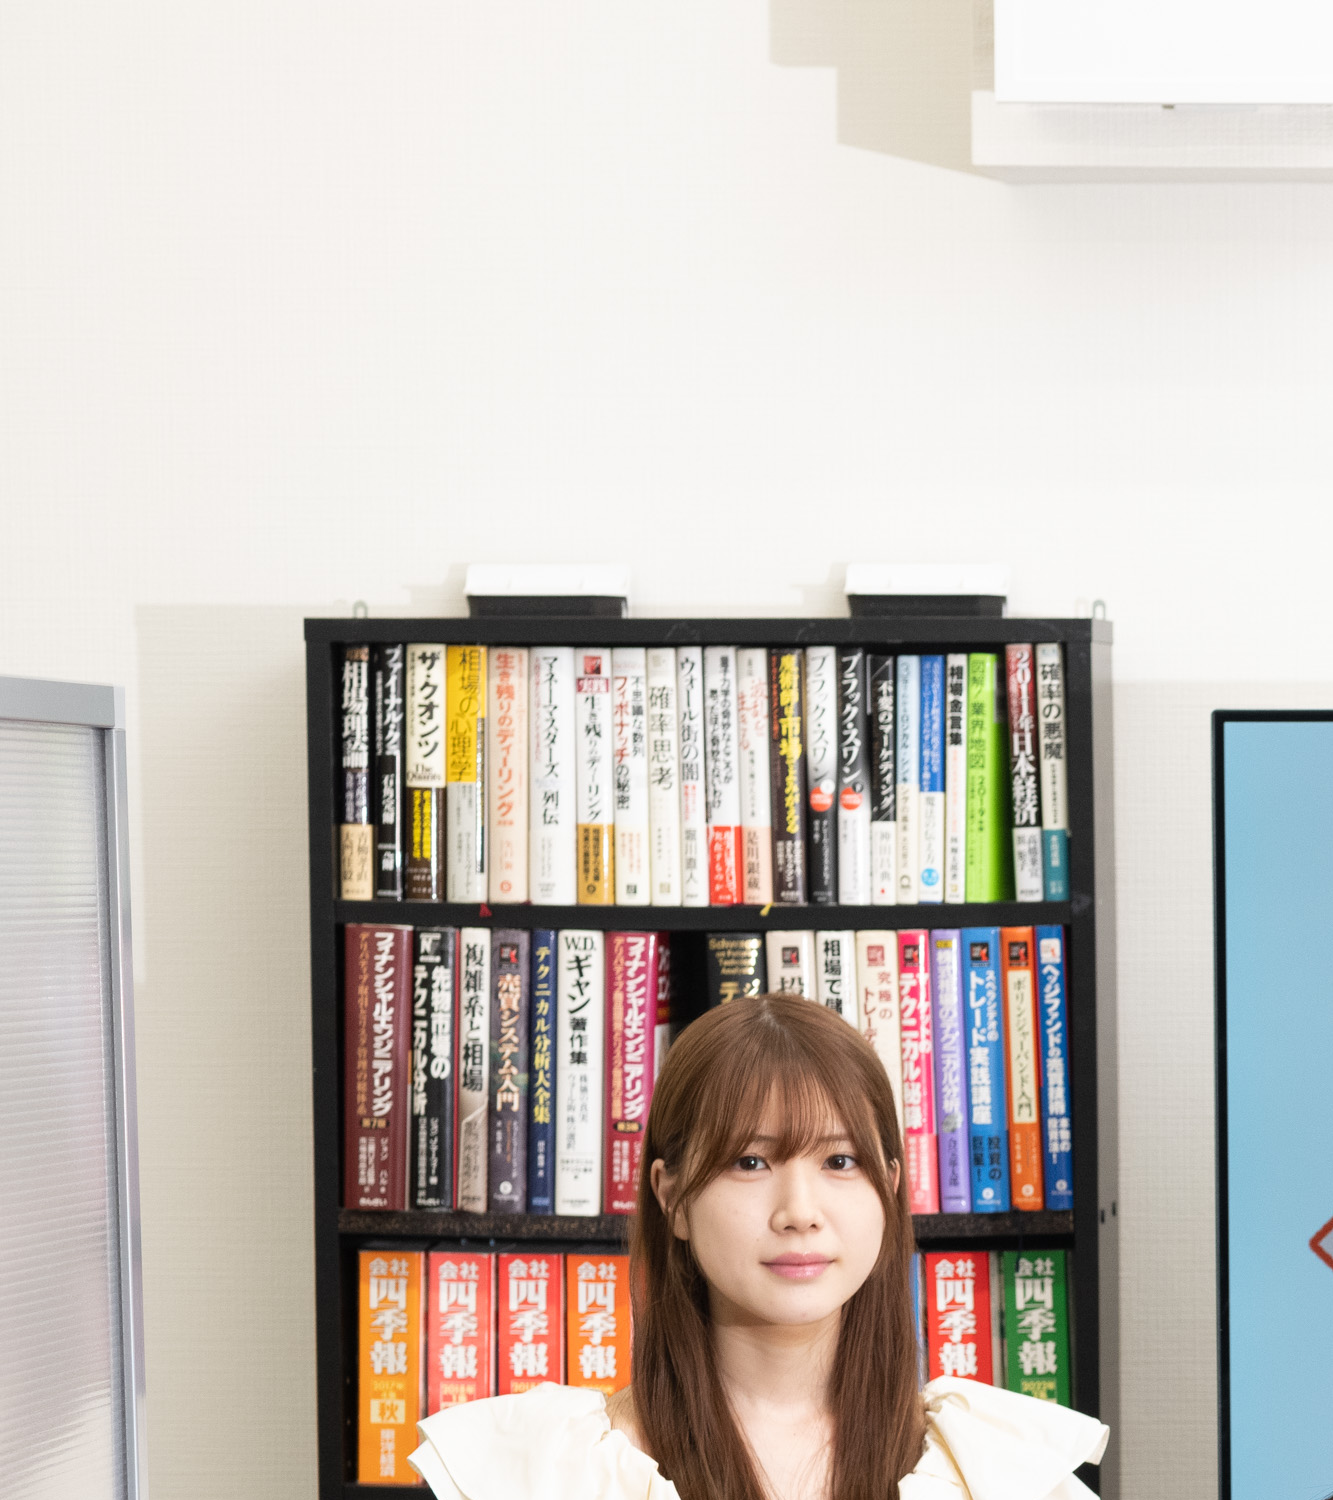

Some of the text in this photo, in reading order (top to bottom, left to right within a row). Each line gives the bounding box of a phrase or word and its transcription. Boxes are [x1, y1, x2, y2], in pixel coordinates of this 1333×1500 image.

[418, 651, 441, 758] ザ・クオンツ
[450, 648, 481, 782] 相場の心理学
[496, 653, 515, 818] 生き残りのディーリング
[614, 676, 631, 811] フィボナッチの秘密
[631, 675, 645, 759] 不思議な数列
[649, 686, 675, 791] 確率思考
[680, 656, 699, 782] ウォール街の闇
[811, 654, 830, 783] ブラック・スワン
[841, 652, 861, 784] ブラック・スワン
[878, 680, 894, 810] 不変のマーケティング
[949, 664, 963, 746] 相場金言集
[1012, 650, 1037, 826] 2011年日本経済
[1041, 663, 1062, 760] 確率の悪魔
[565, 936, 597, 951] W.D.
[876, 971, 892, 1020] 究極の
[372, 932, 395, 1117] フィナンシャルエンジニアリング
[413, 964, 429, 1116] テクニカル分析
[430, 964, 452, 1080] 先物市場の
[462, 943, 485, 1093] 複雑系と相場
[496, 973, 522, 1113] 売買システム入門
[533, 945, 552, 1125] テクニカル分析大全集
[622, 936, 647, 1120] フィナンシャルエンジニアリング
[899, 973, 924, 1130] テクニカル秘録
[969, 970, 993, 1125] トレード実践講座
[1013, 976, 1033, 1118] ボリンジャーバンド入門
[378, 1402, 400, 1422] 秋
